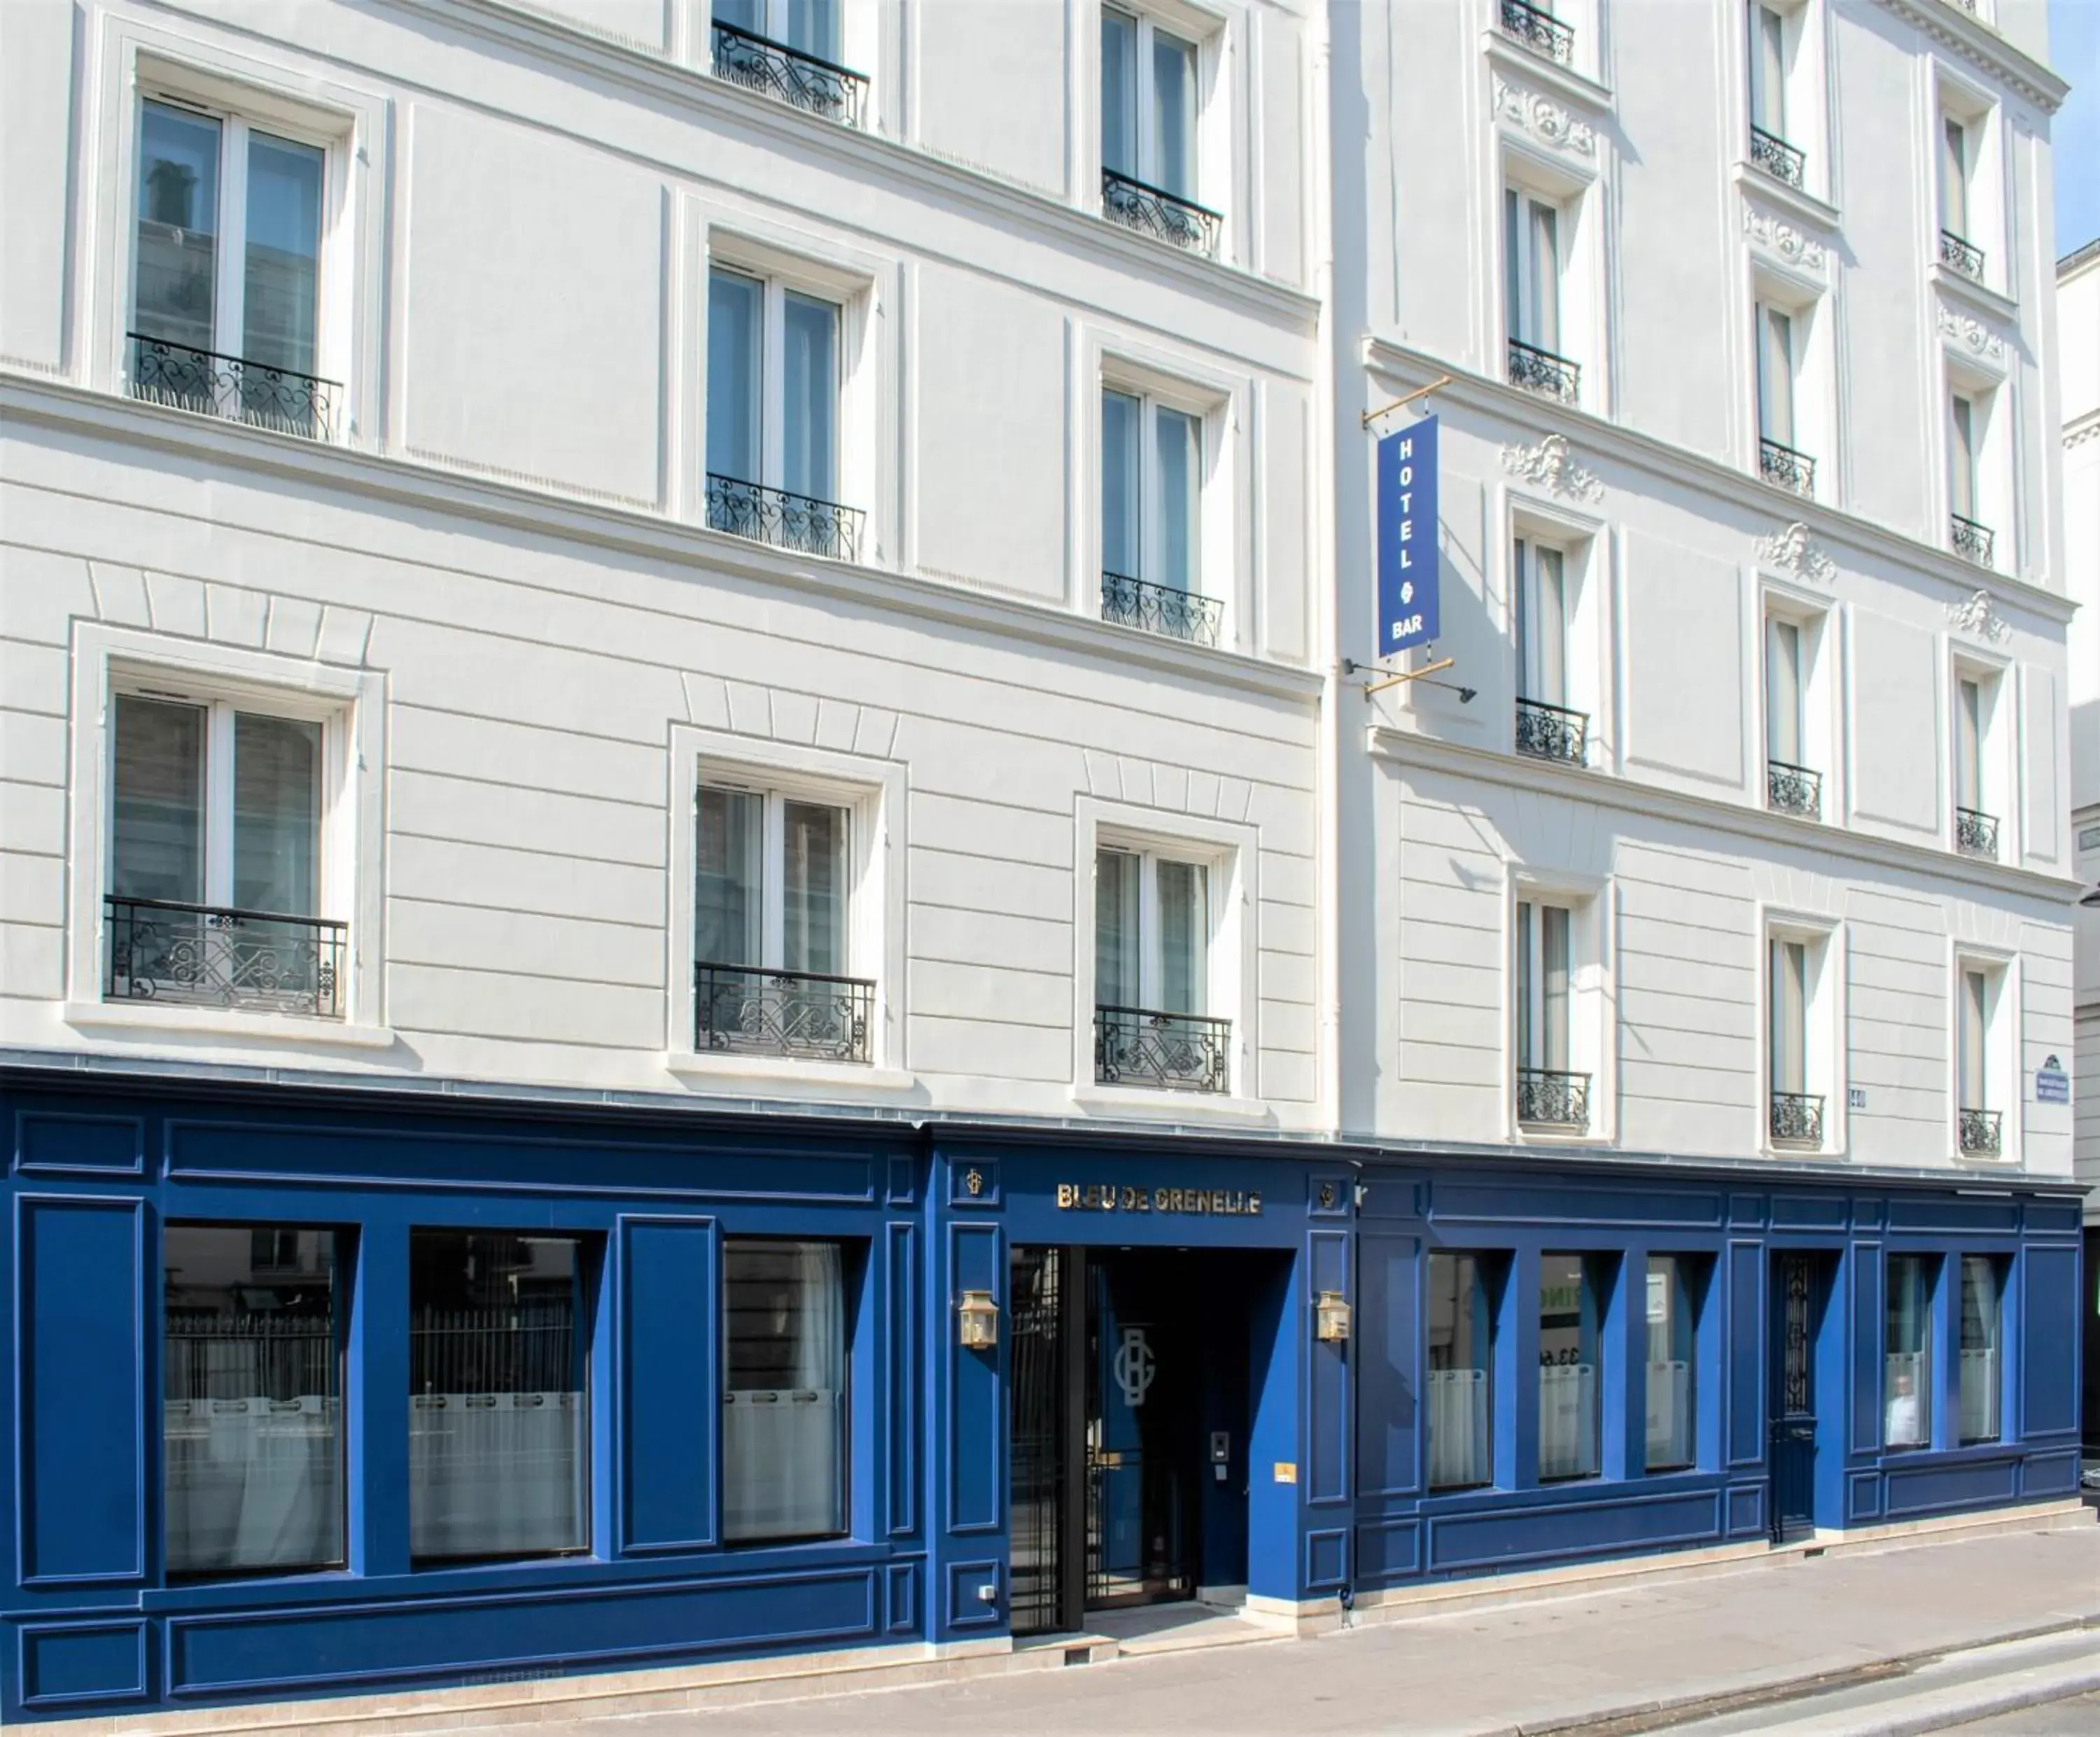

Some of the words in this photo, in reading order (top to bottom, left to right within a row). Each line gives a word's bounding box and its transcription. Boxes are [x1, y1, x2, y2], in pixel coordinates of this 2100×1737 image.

[1400, 438, 1413, 570] HOTEL
[1391, 614, 1423, 640] BAR
[1056, 1183, 1116, 1209] BLEU
[1121, 1186, 1150, 1210] DE
[1155, 1187, 1261, 1214] GRENELLE
